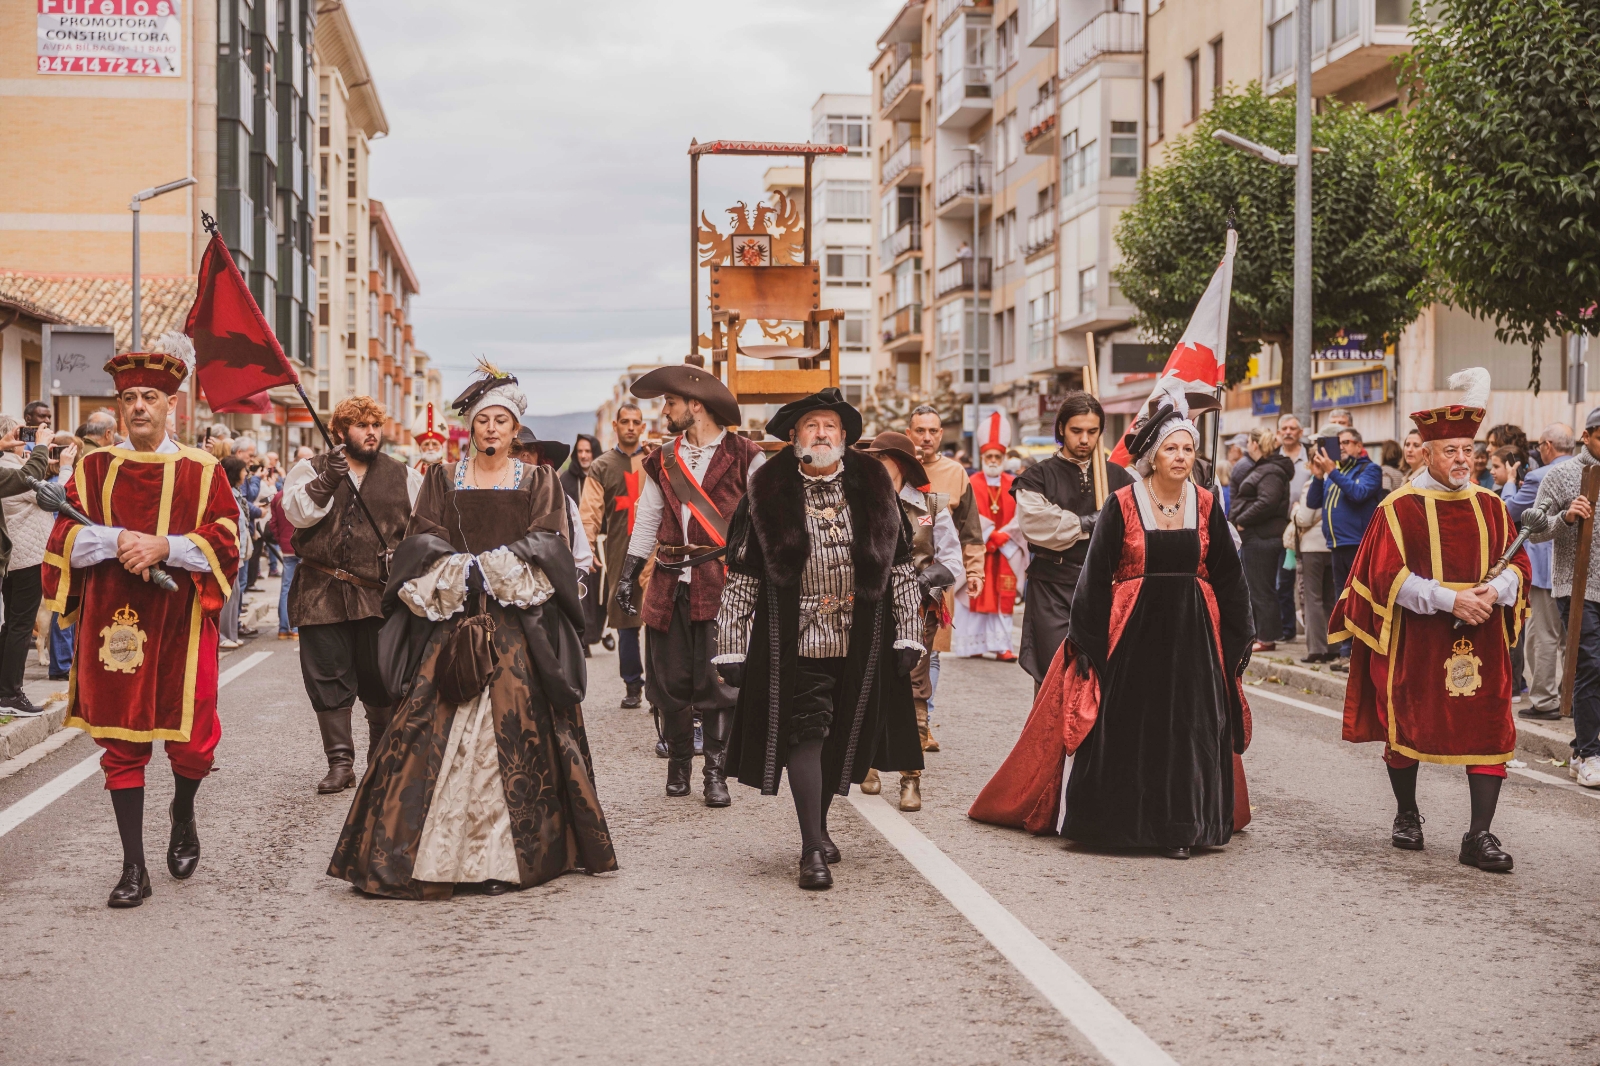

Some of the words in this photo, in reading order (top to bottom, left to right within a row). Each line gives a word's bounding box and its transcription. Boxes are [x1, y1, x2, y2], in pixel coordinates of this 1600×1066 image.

[42, 0, 170, 17] Furelos
[60, 16, 158, 28] PROMOTORA
[46, 29, 170, 42] CONSTRUCTORA
[42, 43, 72, 51] AVDA
[148, 45, 176, 53] BAJO
[38, 56, 75, 72] 947
[78, 57, 101, 73] 14
[105, 58, 128, 73] 72
[132, 59, 156, 73] 42
[1311, 349, 1384, 360] EGUROS
